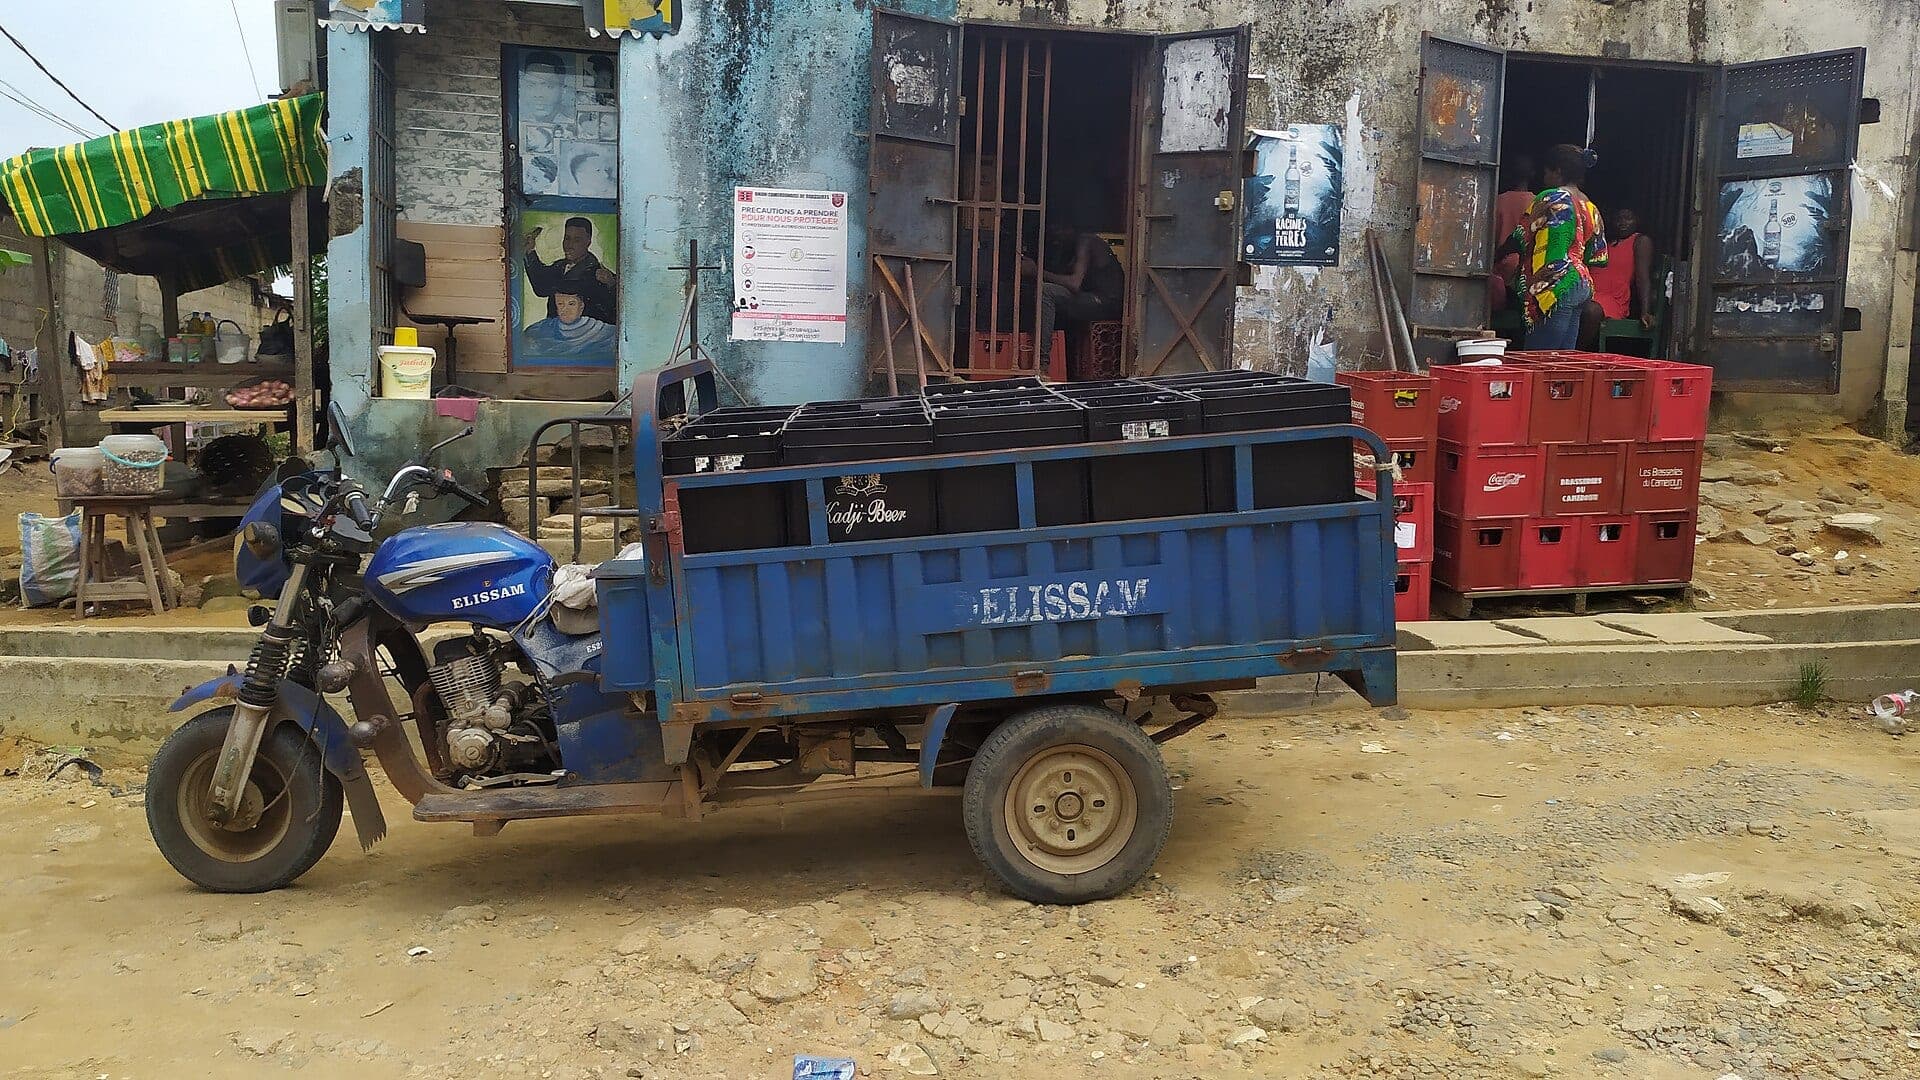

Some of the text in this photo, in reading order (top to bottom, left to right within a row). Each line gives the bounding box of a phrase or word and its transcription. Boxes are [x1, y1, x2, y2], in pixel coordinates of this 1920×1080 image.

[741, 206, 795, 215] PRECAUTIONS
[741, 213, 839, 225] POUR NOUS PROTEGER
[1275, 217, 1307, 230] RACINES
[1275, 231, 1307, 247] TERRES
[1639, 467, 1651, 477] Les
[1576, 486, 1586, 494] DU
[867, 498, 907, 523] Beer
[451, 583, 526, 609] ELISSAM
[979, 578, 1150, 625] ELISSAM
